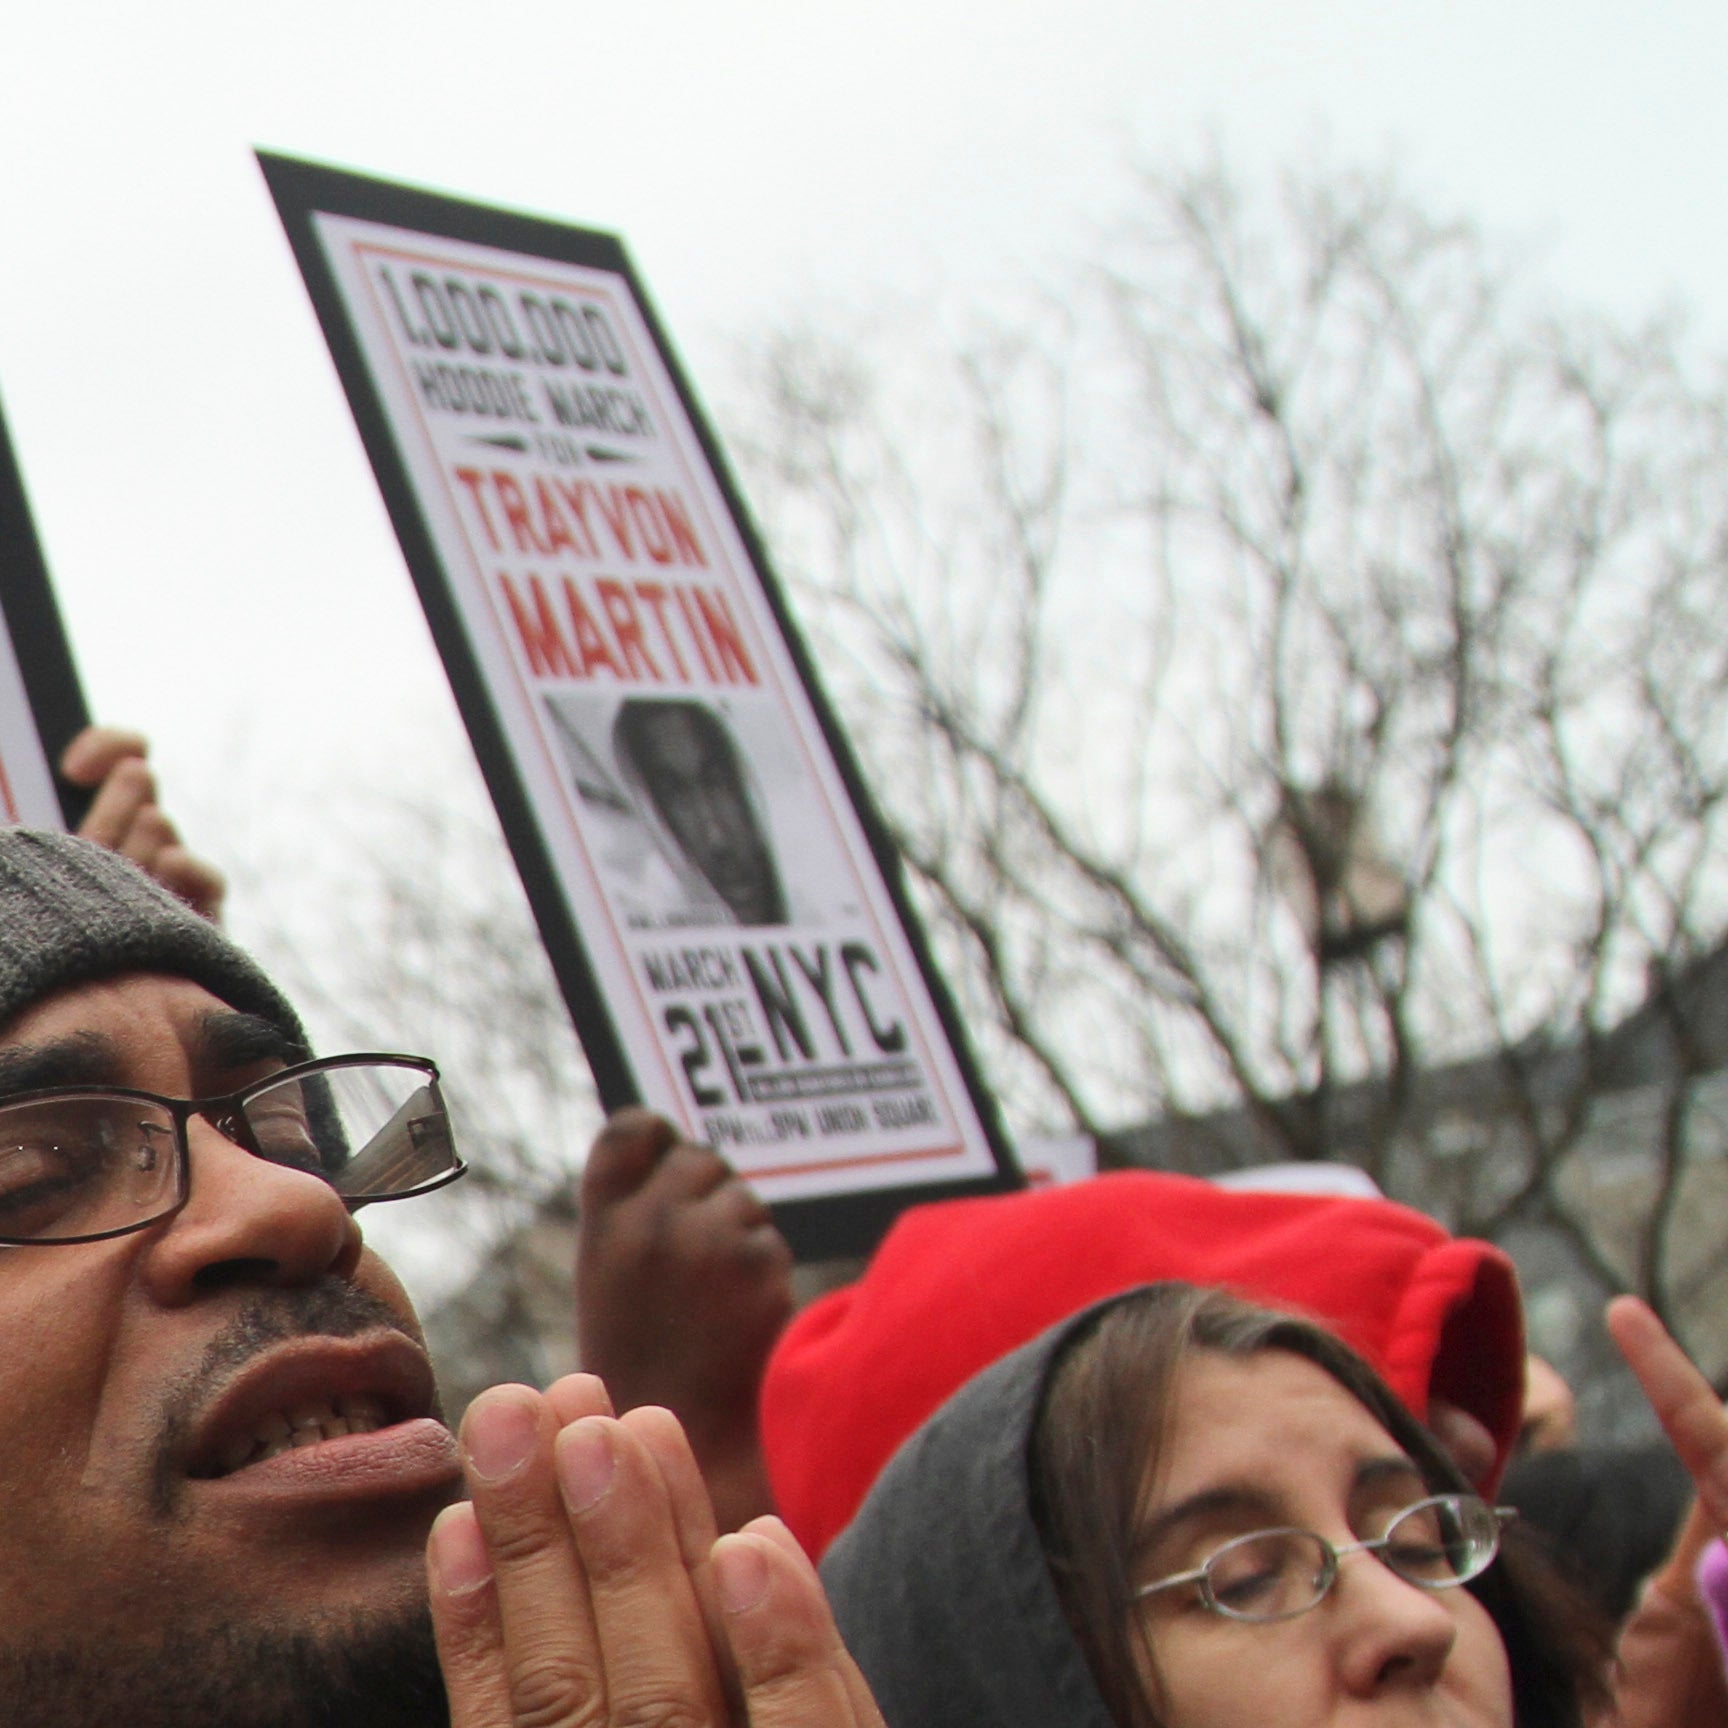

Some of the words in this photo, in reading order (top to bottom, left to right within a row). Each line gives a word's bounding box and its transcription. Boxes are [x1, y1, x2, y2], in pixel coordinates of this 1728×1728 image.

[412, 356, 539, 422] HOODIE
[546, 381, 655, 438] MARCH
[454, 466, 709, 569] TRAYVON
[498, 571, 761, 686] MARTIN
[744, 940, 907, 1063] NYC
